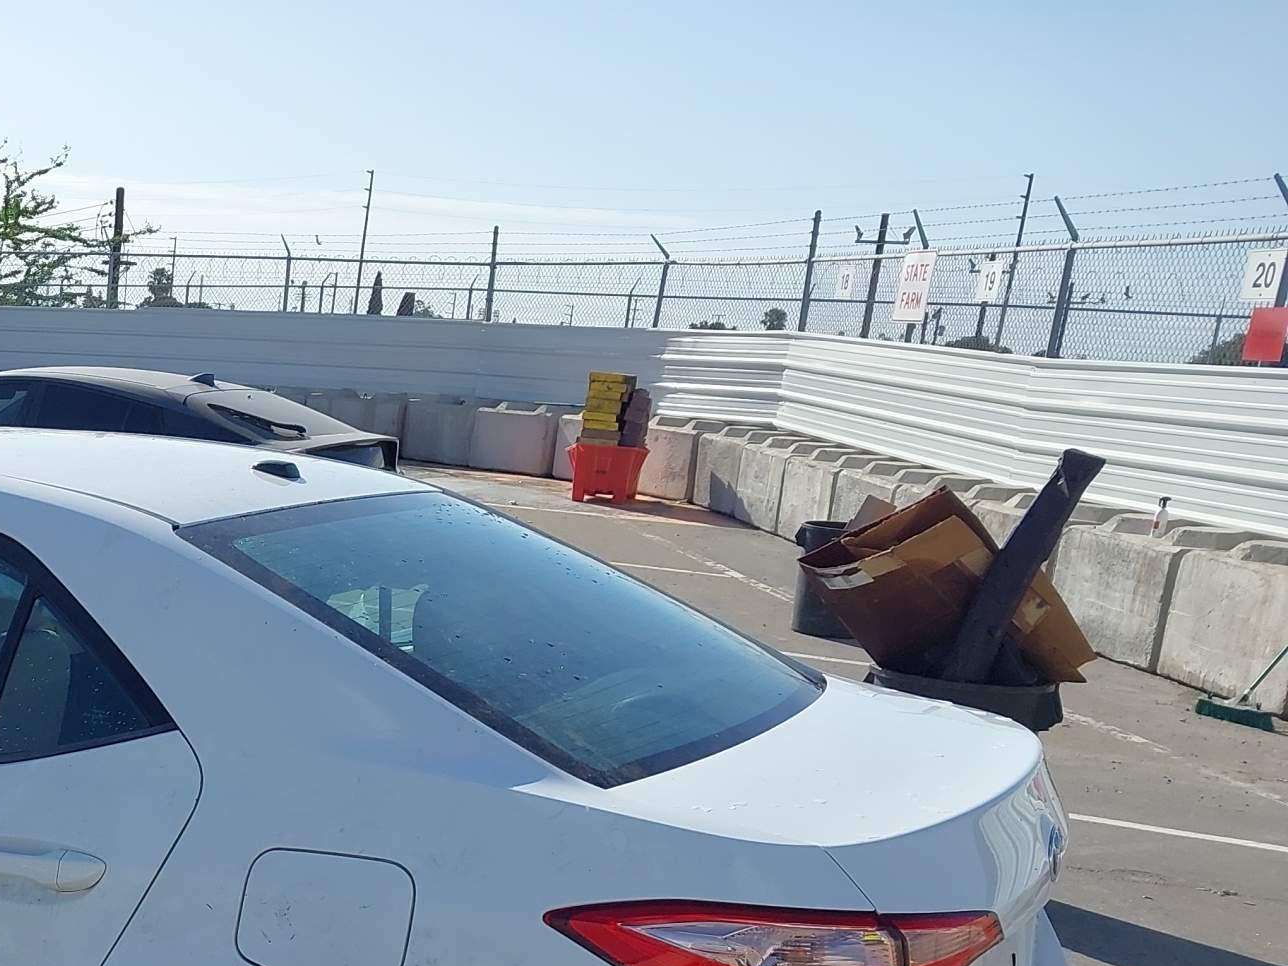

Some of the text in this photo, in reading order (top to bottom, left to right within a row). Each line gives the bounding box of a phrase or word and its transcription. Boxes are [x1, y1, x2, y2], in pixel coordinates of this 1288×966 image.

[904, 263, 930, 282] STATE
[984, 271, 996, 291] 19
[1252, 262, 1276, 288] 20
[900, 292, 922, 309] FARM
